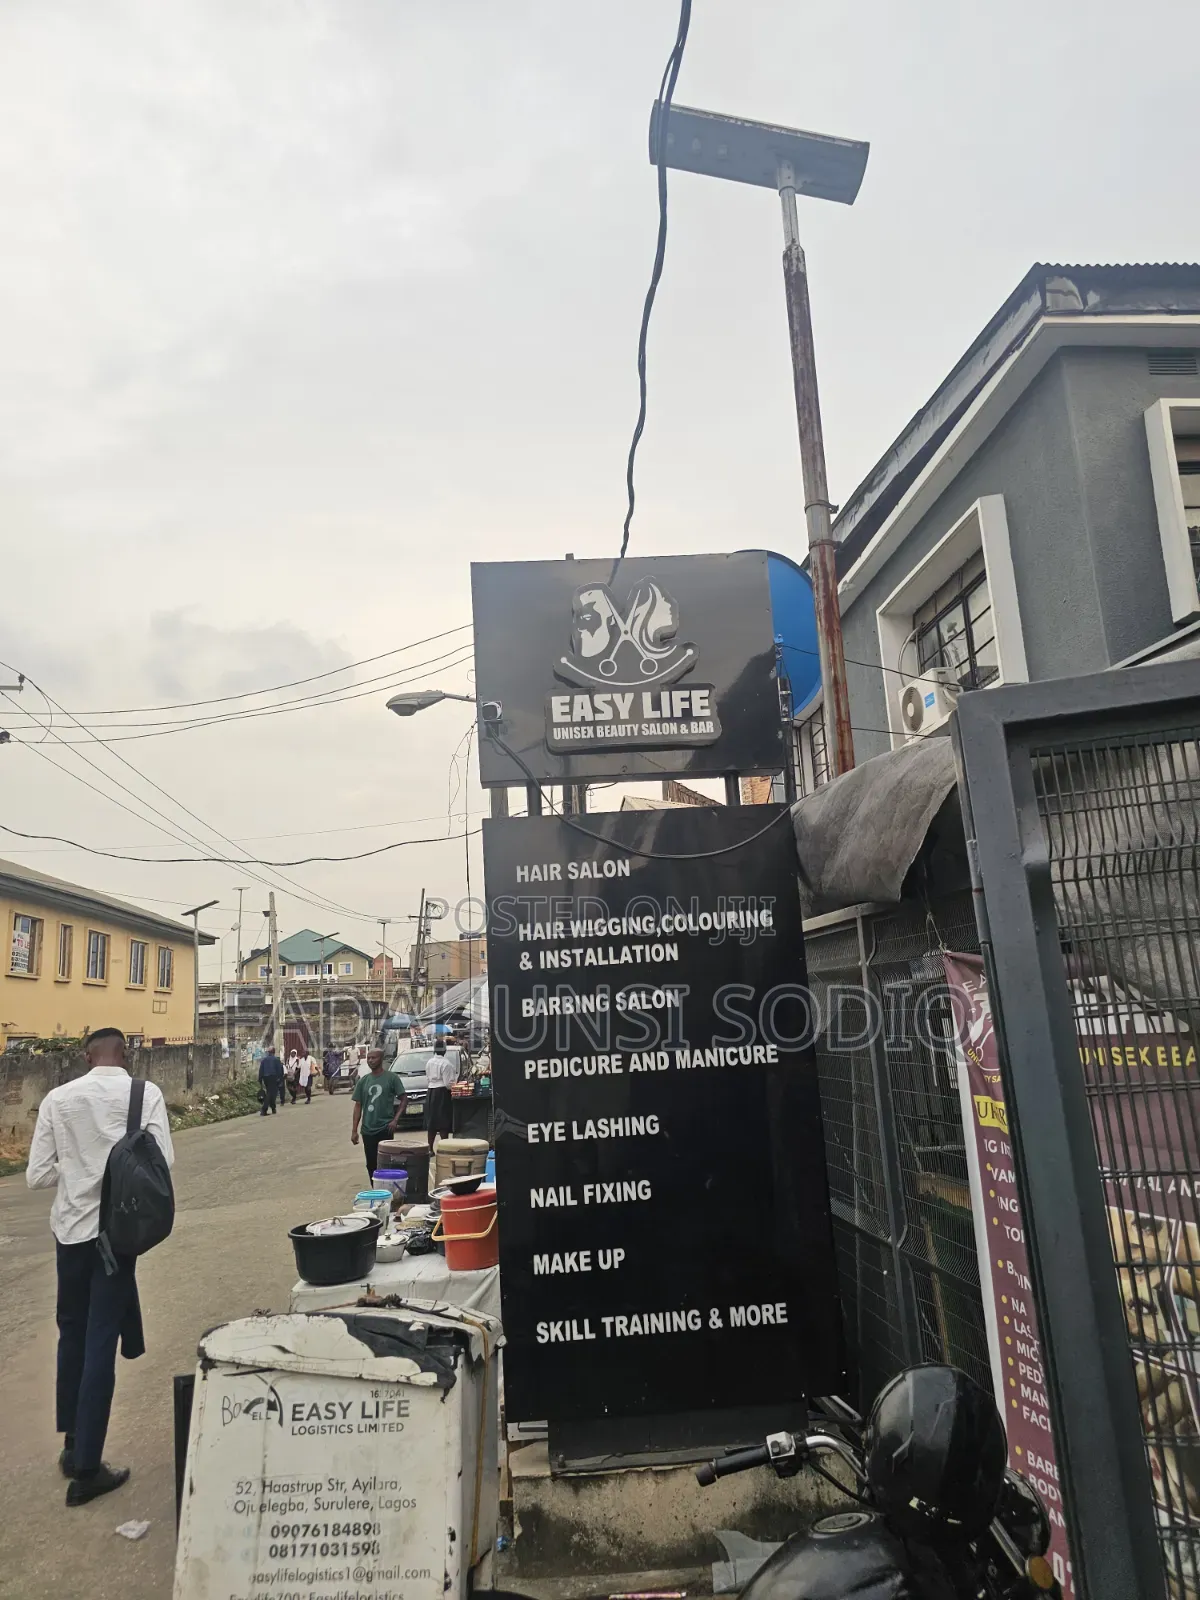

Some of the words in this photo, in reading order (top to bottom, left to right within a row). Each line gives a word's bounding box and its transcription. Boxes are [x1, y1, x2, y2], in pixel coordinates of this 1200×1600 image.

[551, 690, 635, 723] EASY
[642, 689, 711, 719] LIFE
[553, 726, 594, 740] UNISEX
[596, 724, 639, 738] BEAUTY
[641, 722, 678, 736] SALON
[680, 723, 689, 735] &
[690, 721, 714, 734] BAR
[516, 862, 562, 883] HAIR
[567, 859, 631, 880] SALON
[518, 922, 565, 942] HAIR
[518, 951, 533, 971] &
[539, 943, 679, 969] INSTALLATION
[521, 993, 610, 1018] BARBING
[615, 989, 680, 1011] SALON
[524, 1053, 623, 1079] PEDICURE
[629, 1051, 670, 1073] AND
[675, 1044, 779, 1069] MANICURE
[367, 1084, 383, 1112] ?
[527, 1121, 566, 1143] EYE
[572, 1114, 660, 1140] LASHING
[530, 1186, 577, 1208] NAIL
[583, 1179, 652, 1205] FIXING
[533, 1250, 592, 1275] MAKE
[598, 1248, 626, 1270] UP
[536, 1318, 596, 1344] SKILL
[601, 1309, 702, 1338] TRAINING
[708, 1308, 723, 1329] &
[729, 1302, 788, 1327] MORE
[291, 1400, 353, 1422] EASY
[361, 1399, 410, 1419] LIFE
[291, 1423, 353, 1436] LOGISTICS
[358, 1422, 404, 1433] LIMITED
[235, 1480, 257, 1496] 52,
[261, 1479, 323, 1496] Haastrup
[327, 1477, 347, 1494] Str,
[313, 1495, 374, 1512] Surulere,
[378, 1496, 417, 1512] Lagos
